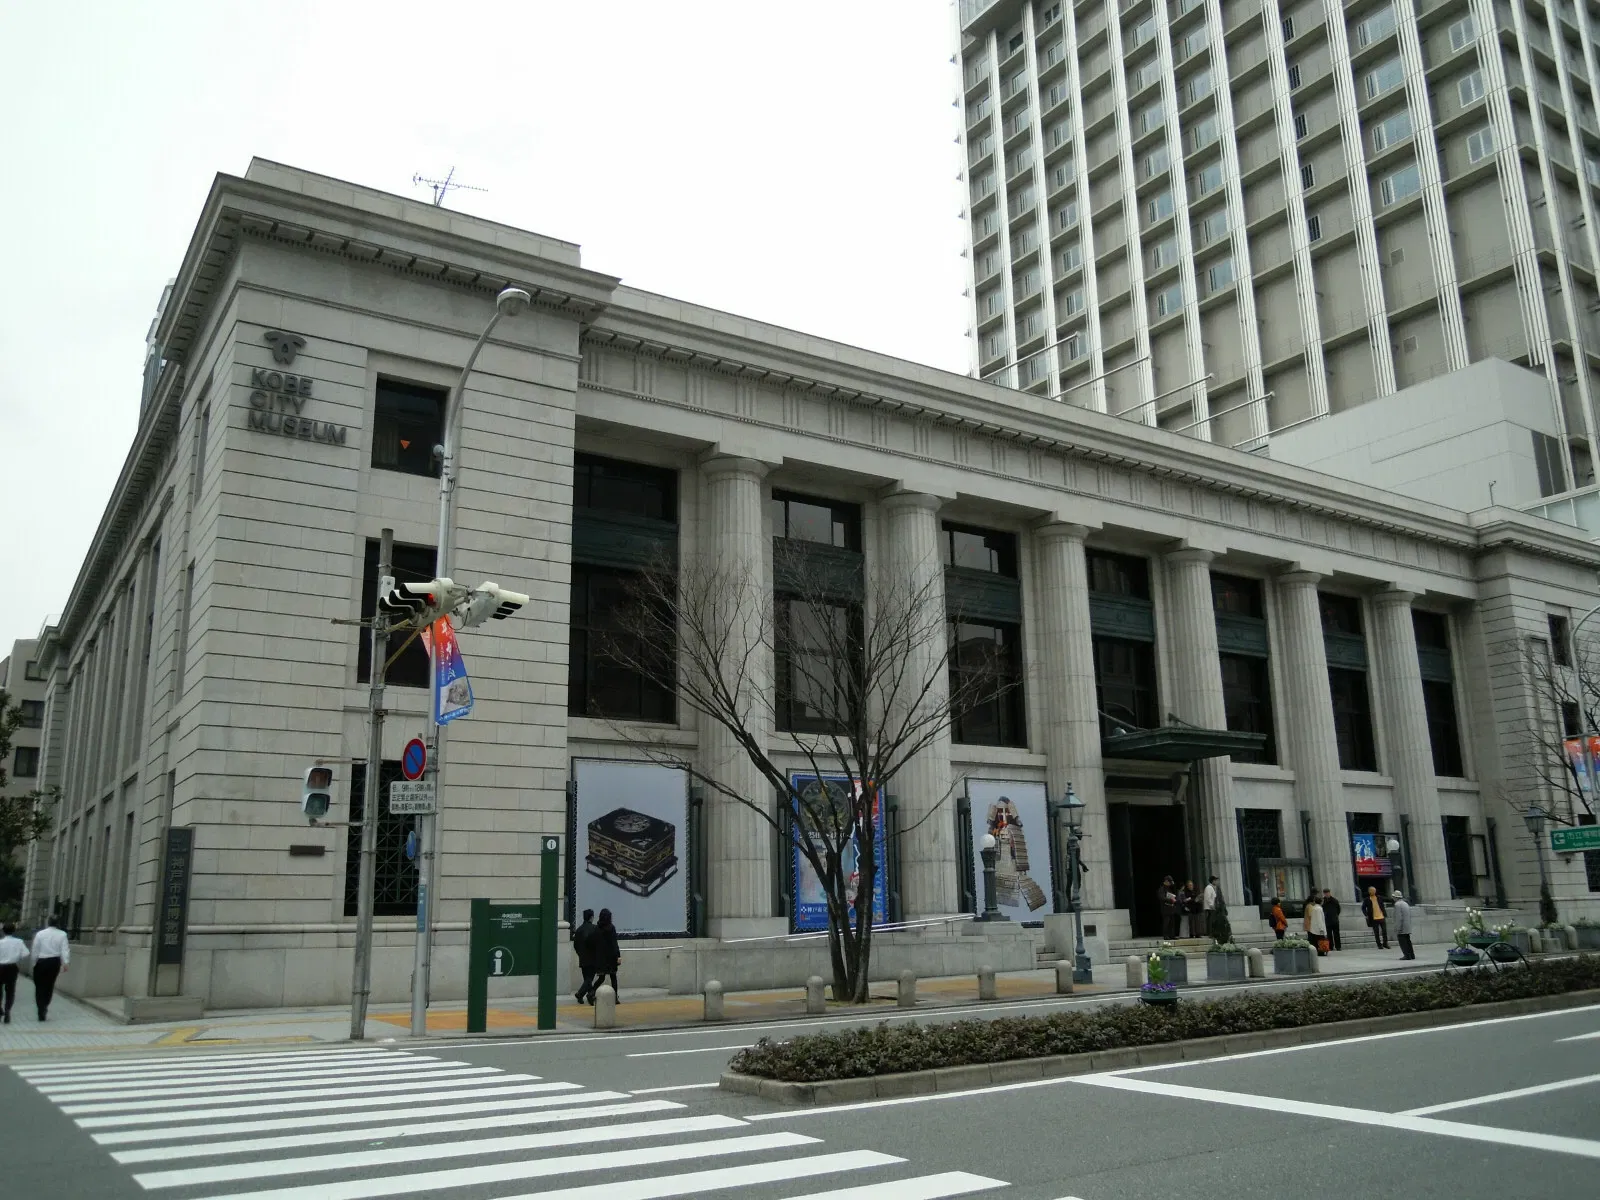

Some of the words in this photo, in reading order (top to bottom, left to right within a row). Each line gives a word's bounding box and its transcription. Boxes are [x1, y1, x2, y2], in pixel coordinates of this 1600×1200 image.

[251, 367, 313, 397] KOBE
[249, 390, 306, 415] CITY
[247, 408, 347, 444] MUSEUM
[164, 857, 185, 945] 神戸市立博物館
